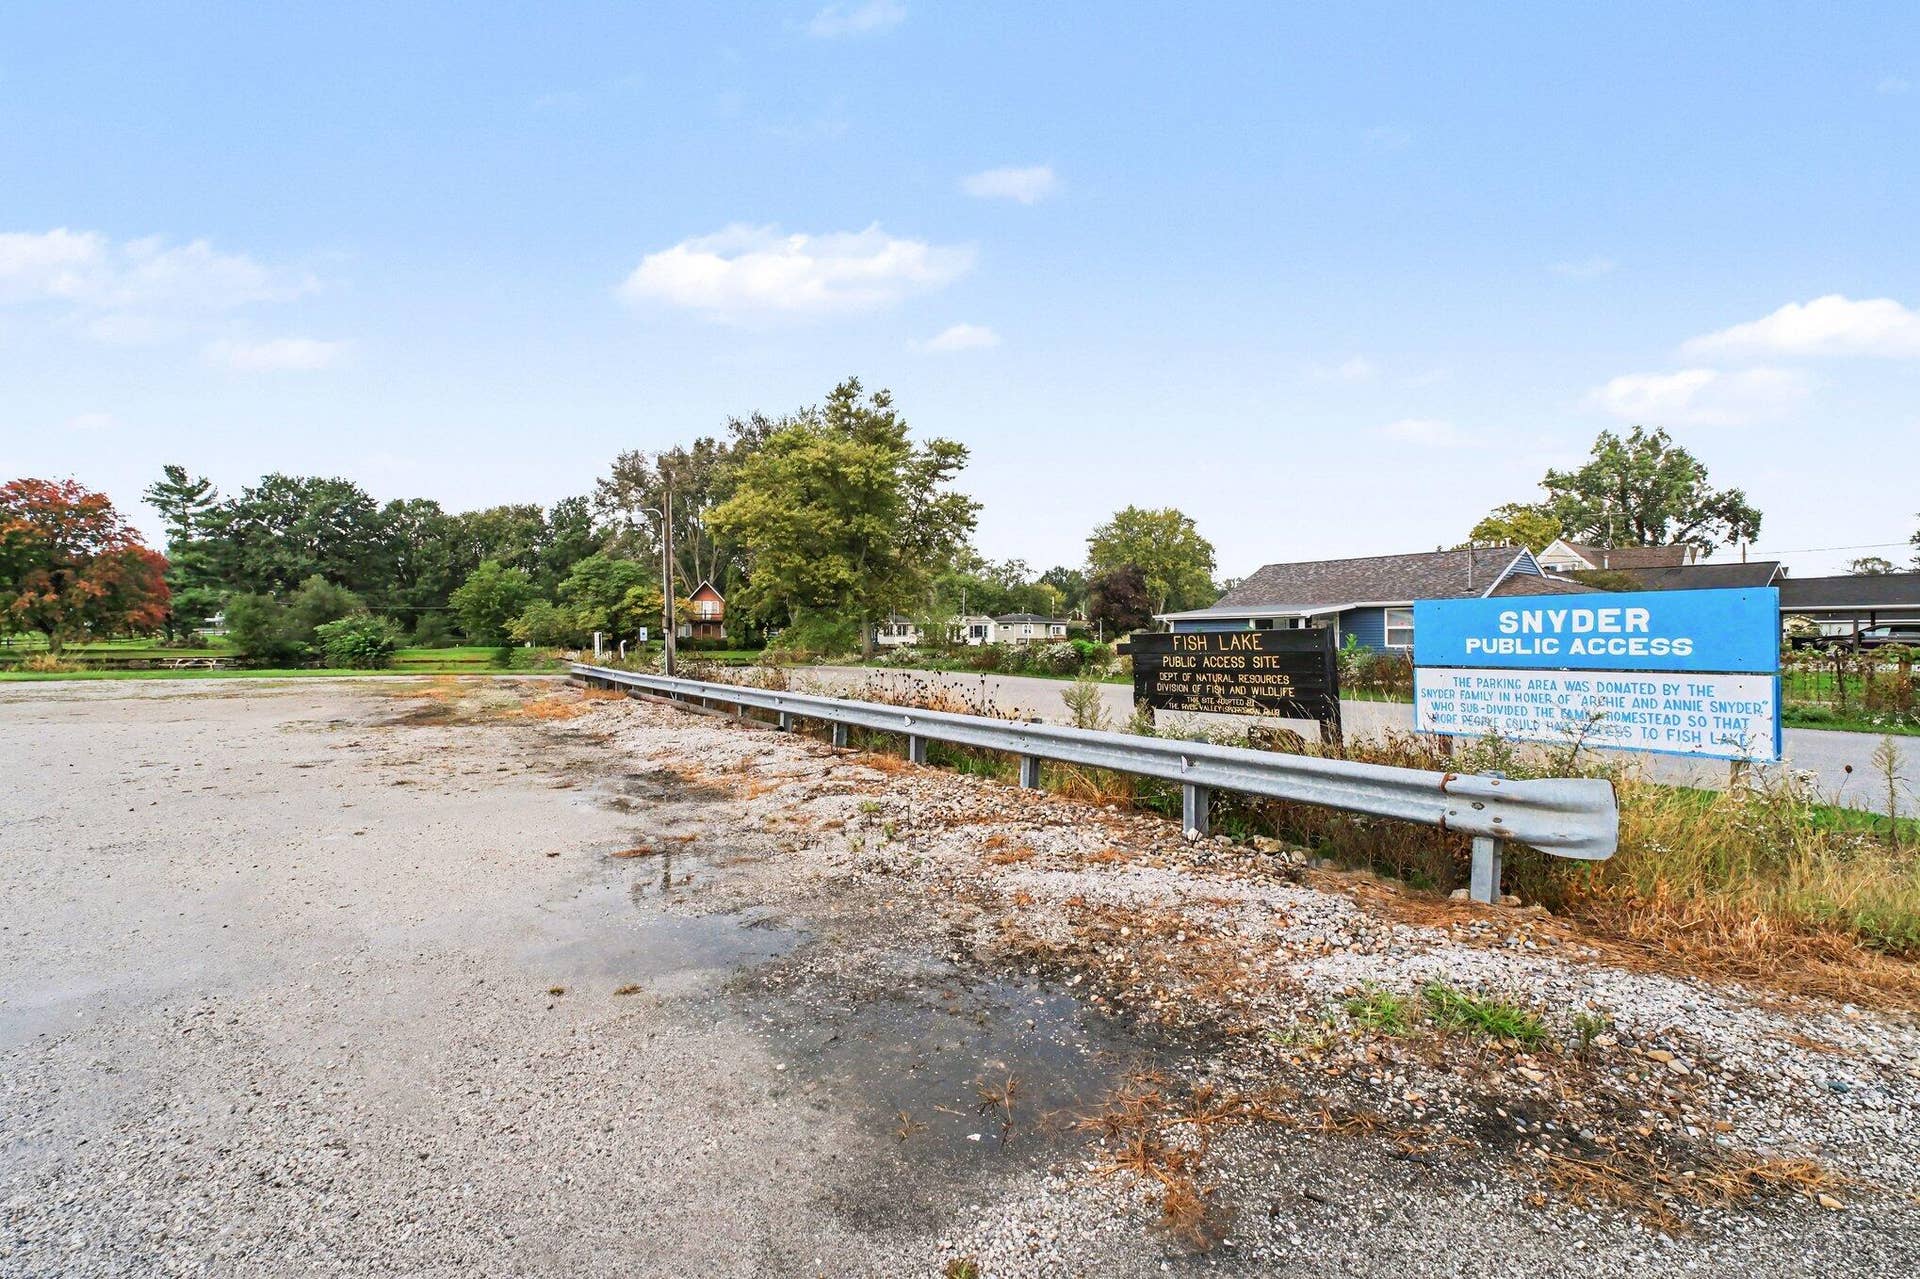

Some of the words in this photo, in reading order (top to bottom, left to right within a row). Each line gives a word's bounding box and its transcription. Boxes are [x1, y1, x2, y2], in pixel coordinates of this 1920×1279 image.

[1499, 607, 1651, 634] SNYDER
[1174, 635, 1207, 651] FISH
[1219, 633, 1263, 651] LAKE
[1465, 638, 1560, 655] PUBLIC
[1568, 637, 1693, 656] ACCESS
[1163, 656, 1196, 668] PUBLIC
[1203, 656, 1245, 668] ACCESS
[1252, 656, 1280, 669] SITE
[1159, 672, 1178, 681] DEPT
[1182, 672, 1192, 682] OF
[1196, 673, 1234, 683] NATURAL
[1238, 674, 1290, 685] RESOURCES
[1453, 676, 1472, 688] THE
[1477, 677, 1521, 690] PARKING
[1528, 679, 1557, 691] AREA
[1564, 680, 1589, 693] WAS
[1597, 681, 1657, 695] DONATED
[1662, 683, 1680, 696] BY
[1687, 684, 1715, 698] THE
[1156, 682, 1189, 693] DIVISION
[1192, 684, 1202, 693] OF
[1207, 684, 1225, 694] FISH
[1229, 685, 1247, 695] AND
[1251, 686, 1295, 697] WILDLIFE
[1169, 702, 1180, 710] THE
[1202, 697, 1214, 705] SITE
[1421, 688, 1455, 699] SNYDER
[1460, 689, 1494, 701] FAMILY
[1499, 692, 1510, 702] IN
[1514, 693, 1552, 704] HONER
[1558, 694, 1571, 705] OF
[1632, 698, 1658, 710] AND
[1663, 699, 1703, 712] ANNIE
[1431, 701, 1455, 712] WHO
[1460, 703, 1528, 717] SUB-DIVIDED
[1534, 706, 1555, 718] THE
[1561, 708, 1601, 721] FAMI
[1688, 715, 1707, 728] SO
[1713, 717, 1750, 731] THAT
[1641, 726, 1658, 740] TO
[1667, 728, 1701, 743] FISH
